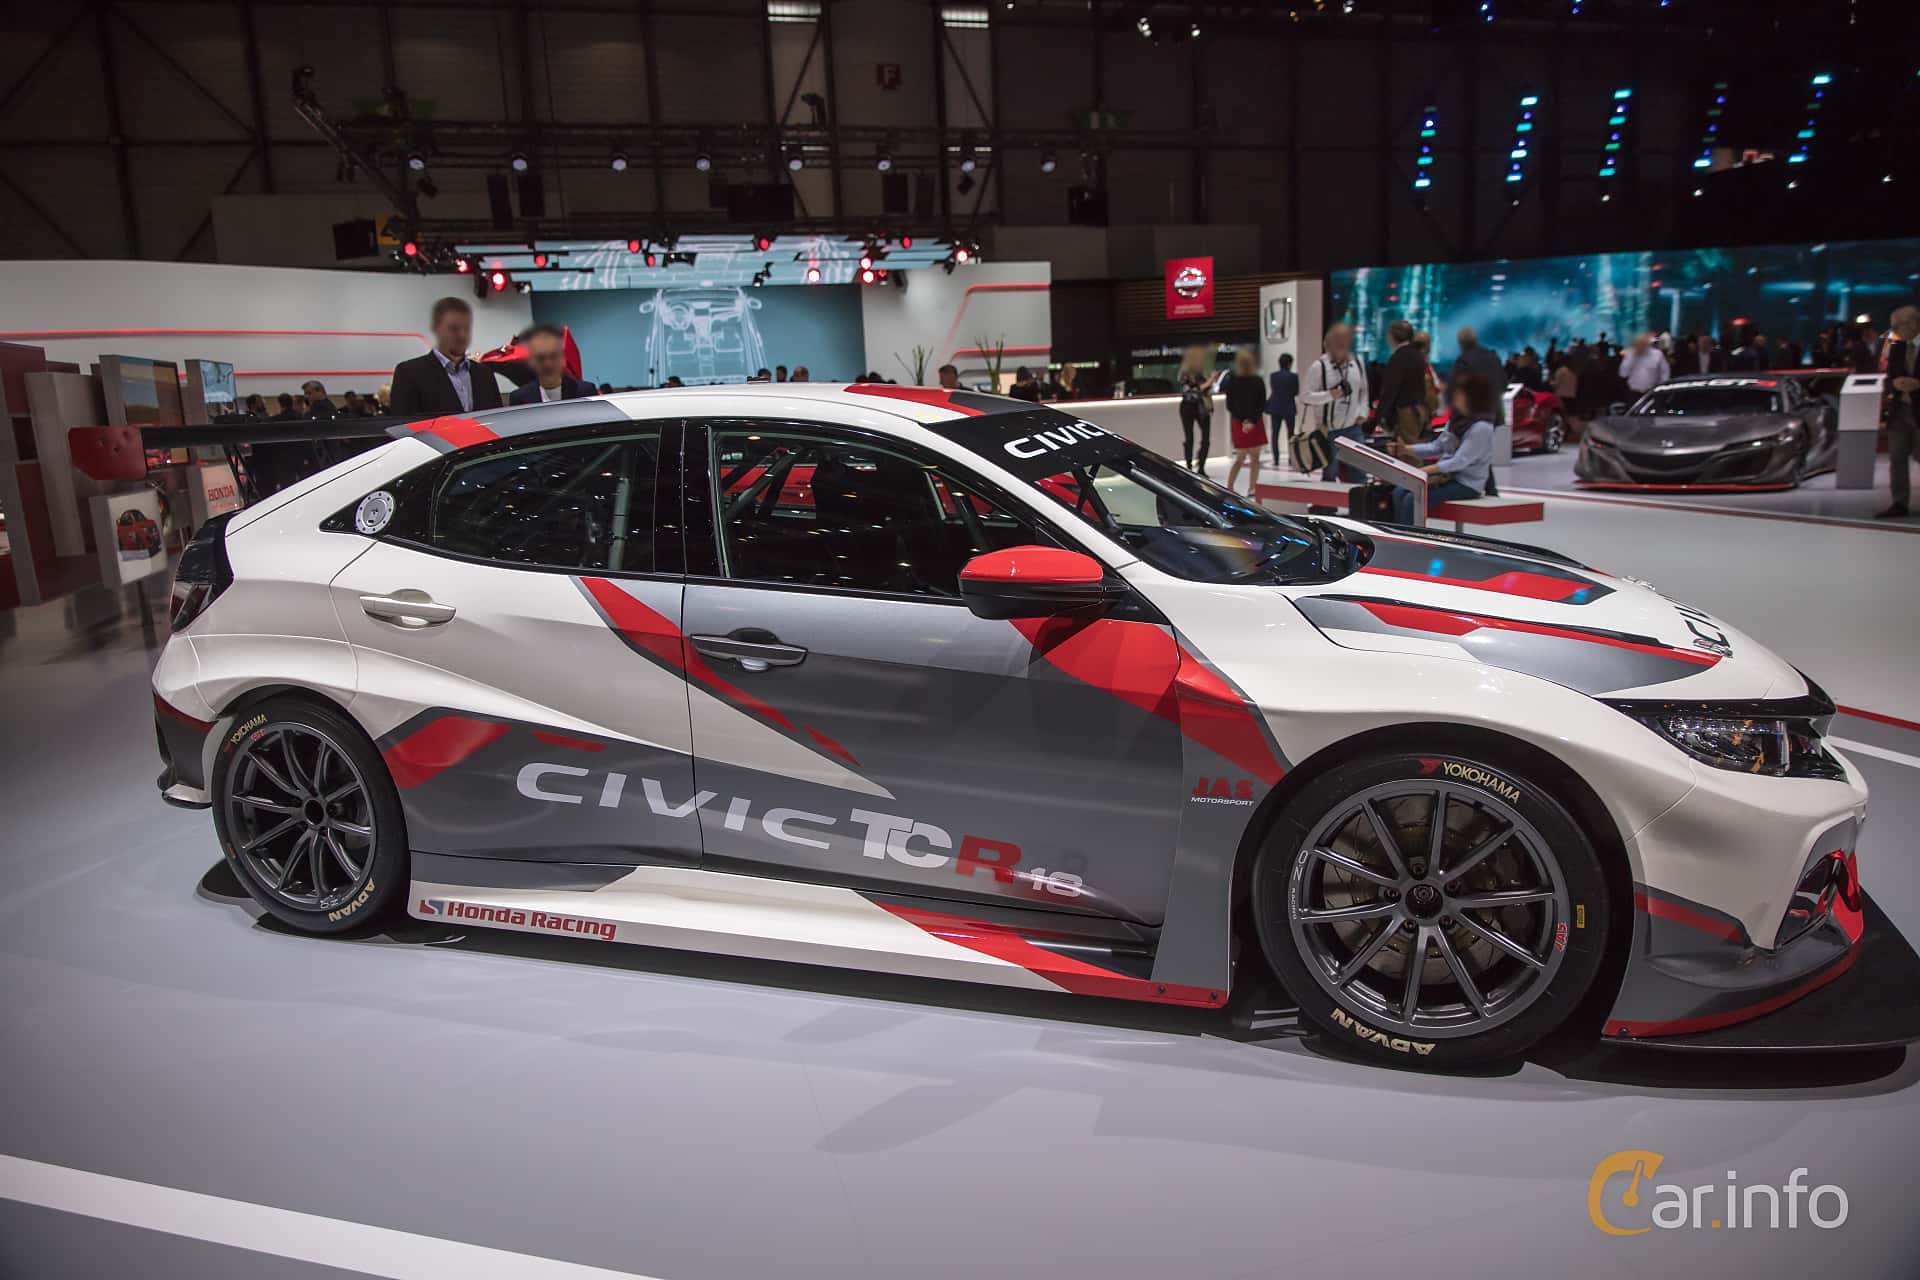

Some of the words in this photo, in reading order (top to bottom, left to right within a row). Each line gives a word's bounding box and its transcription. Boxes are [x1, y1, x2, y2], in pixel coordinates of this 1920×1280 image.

[884, 67, 897, 85] F
[1003, 422, 1105, 459] CIVIC
[230, 713, 268, 745] YOKOHAMA
[1190, 796, 1255, 806] MOTORSPORT
[1191, 776, 1255, 801] JAS
[1442, 761, 1521, 804] YOKOHAMA
[516, 762, 838, 850] CIVIC
[850, 808, 1022, 885] TCR
[1030, 867, 1084, 898] 18
[328, 877, 375, 922] ADVAN
[447, 900, 526, 926] Honda
[530, 911, 617, 941] Racing
[1330, 1008, 1437, 1056] ADVAN
